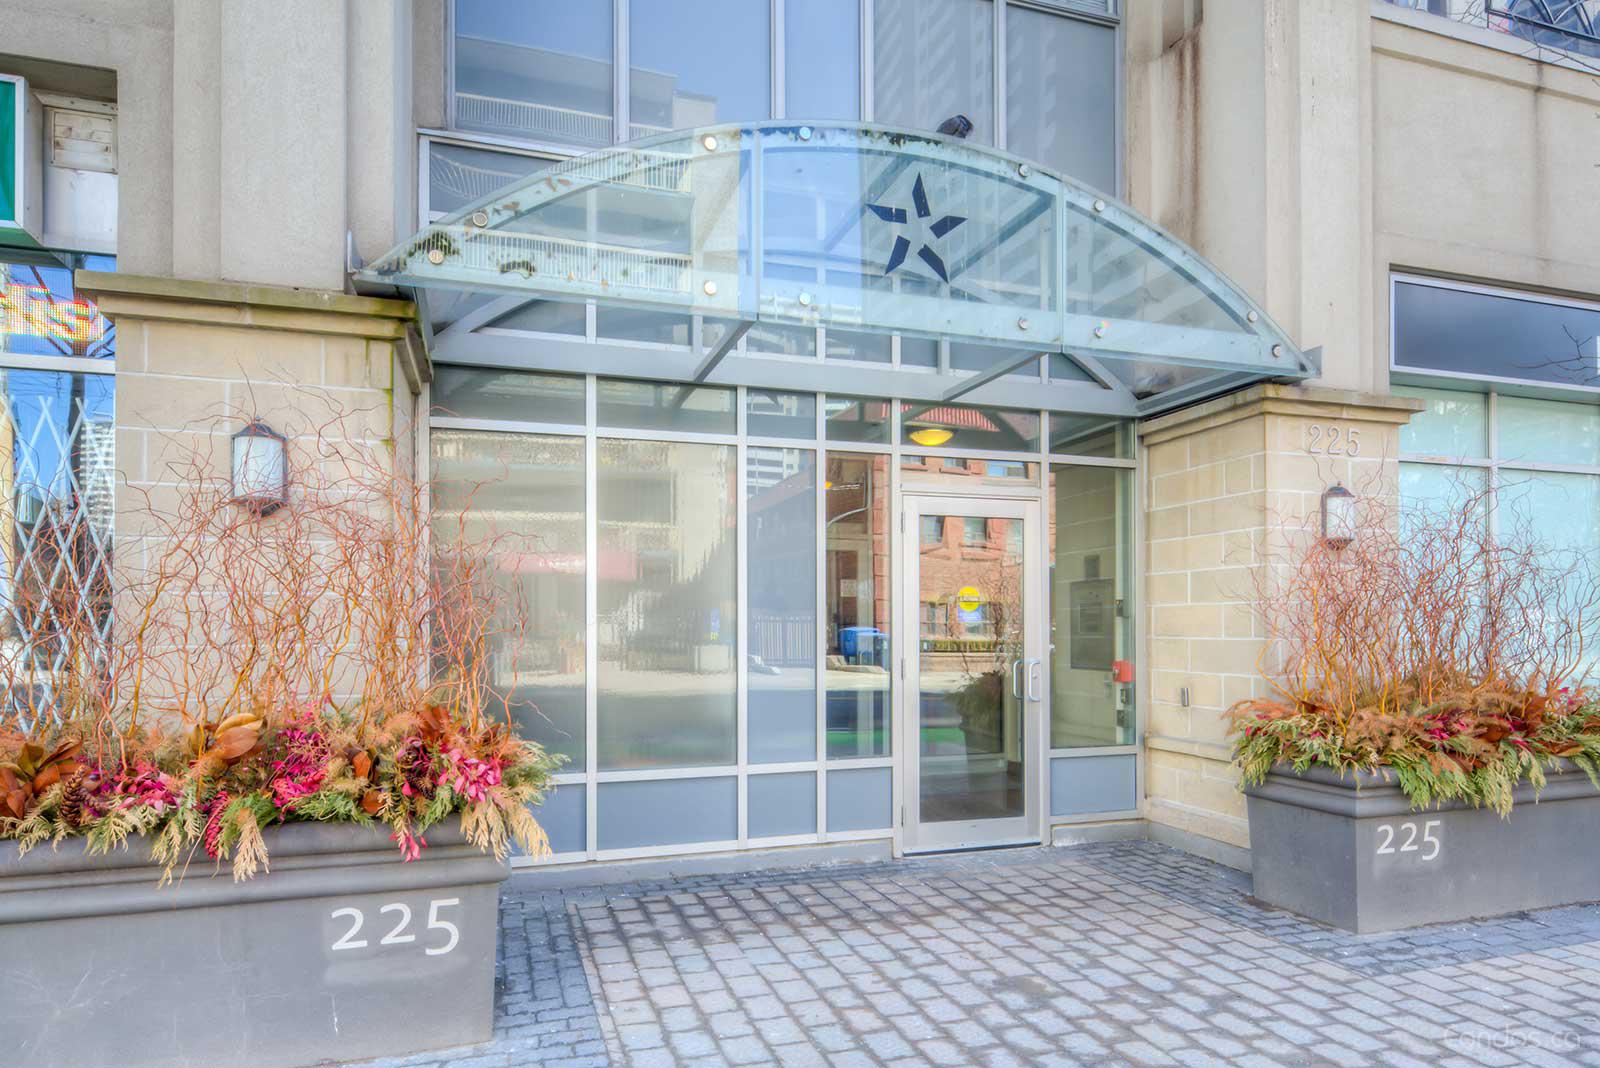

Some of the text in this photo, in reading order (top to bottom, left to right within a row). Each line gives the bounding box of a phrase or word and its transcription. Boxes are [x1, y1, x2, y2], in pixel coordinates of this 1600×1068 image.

[1309, 424, 1361, 457] 225
[1376, 820, 1441, 860] 225
[331, 898, 459, 955] 225
